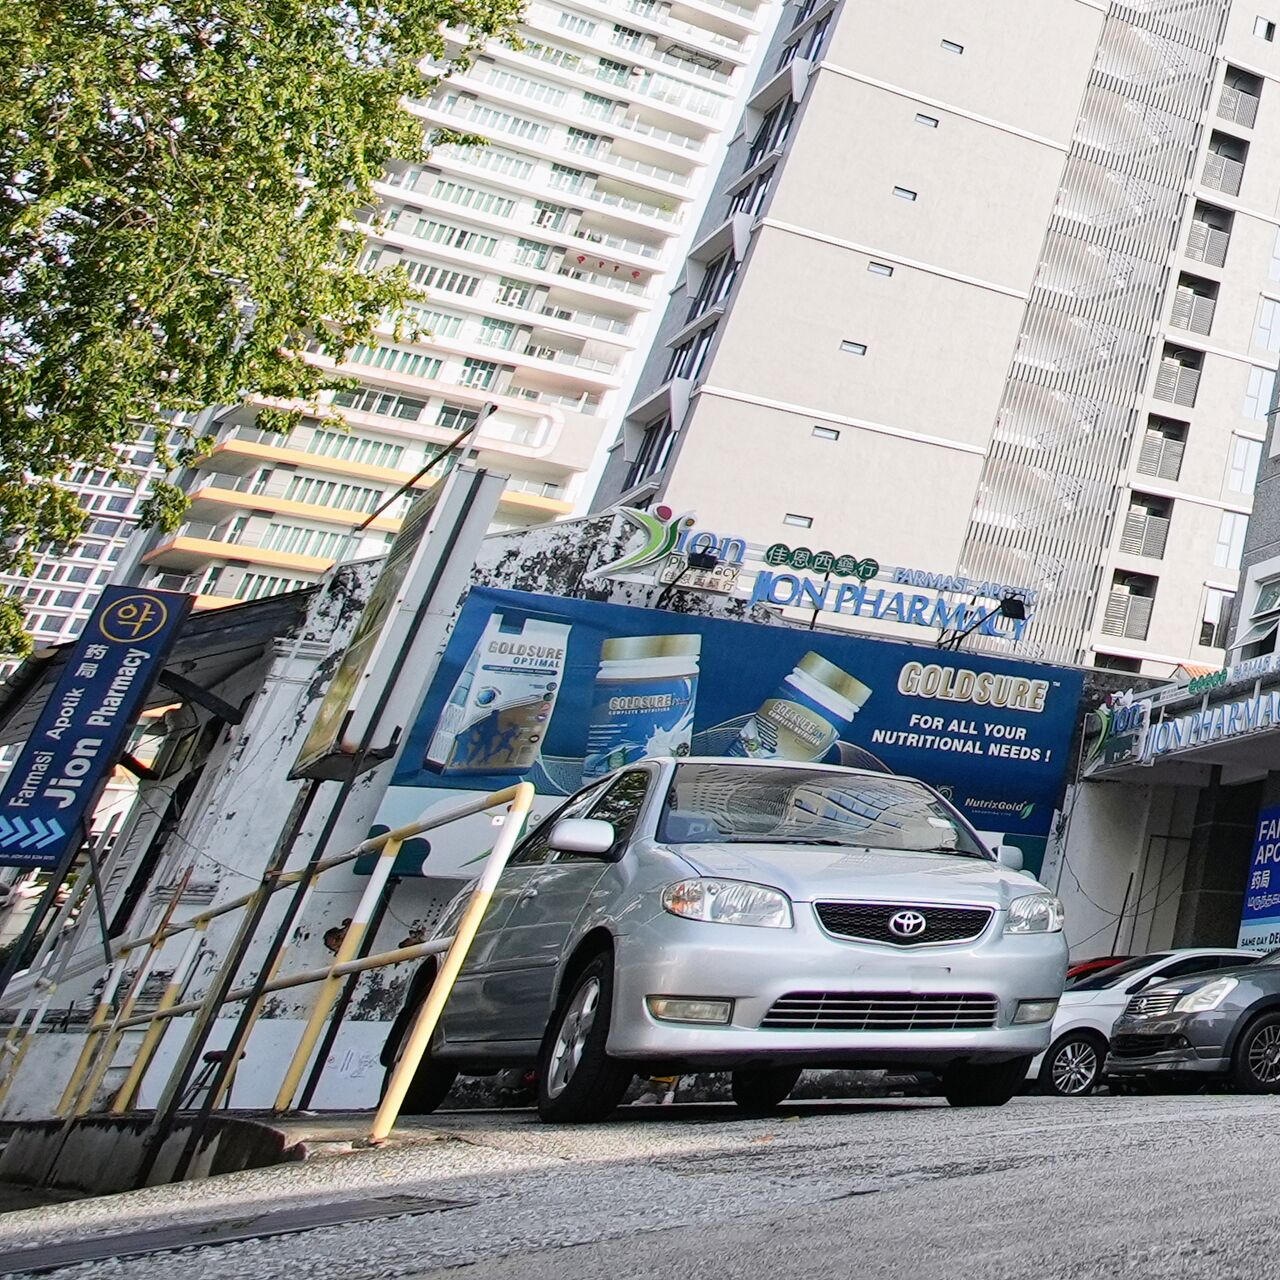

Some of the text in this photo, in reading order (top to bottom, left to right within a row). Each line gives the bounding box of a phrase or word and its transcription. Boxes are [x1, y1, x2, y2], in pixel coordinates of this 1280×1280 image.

[767, 546, 878, 578] 佳恩西藥行
[893, 567, 968, 593] FARMASI
[750, 570, 1035, 642] JION PHARMACY
[488, 641, 564, 660] GOLDSURE
[513, 657, 561, 669] OPTIMAL
[609, 694, 673, 711] GOLDSURE
[897, 661, 1050, 713] GOLDSURE
[43, 648, 151, 809] Jion Pharmacy
[772, 701, 815, 733] GOLDSURE
[909, 714, 1027, 741] FOR ALL YOUR
[8, 750, 56, 808] Farmasi
[46, 686, 85, 741] Apotik
[871, 729, 984, 755] NUTRITIONAL
[988, 743, 1041, 762] NEEDS
[1142, 717, 1189, 764] JION
[965, 797, 1024, 812] NutrixGold
[1241, 937, 1256, 947] SAME
[1256, 935, 1268, 946] DAY
